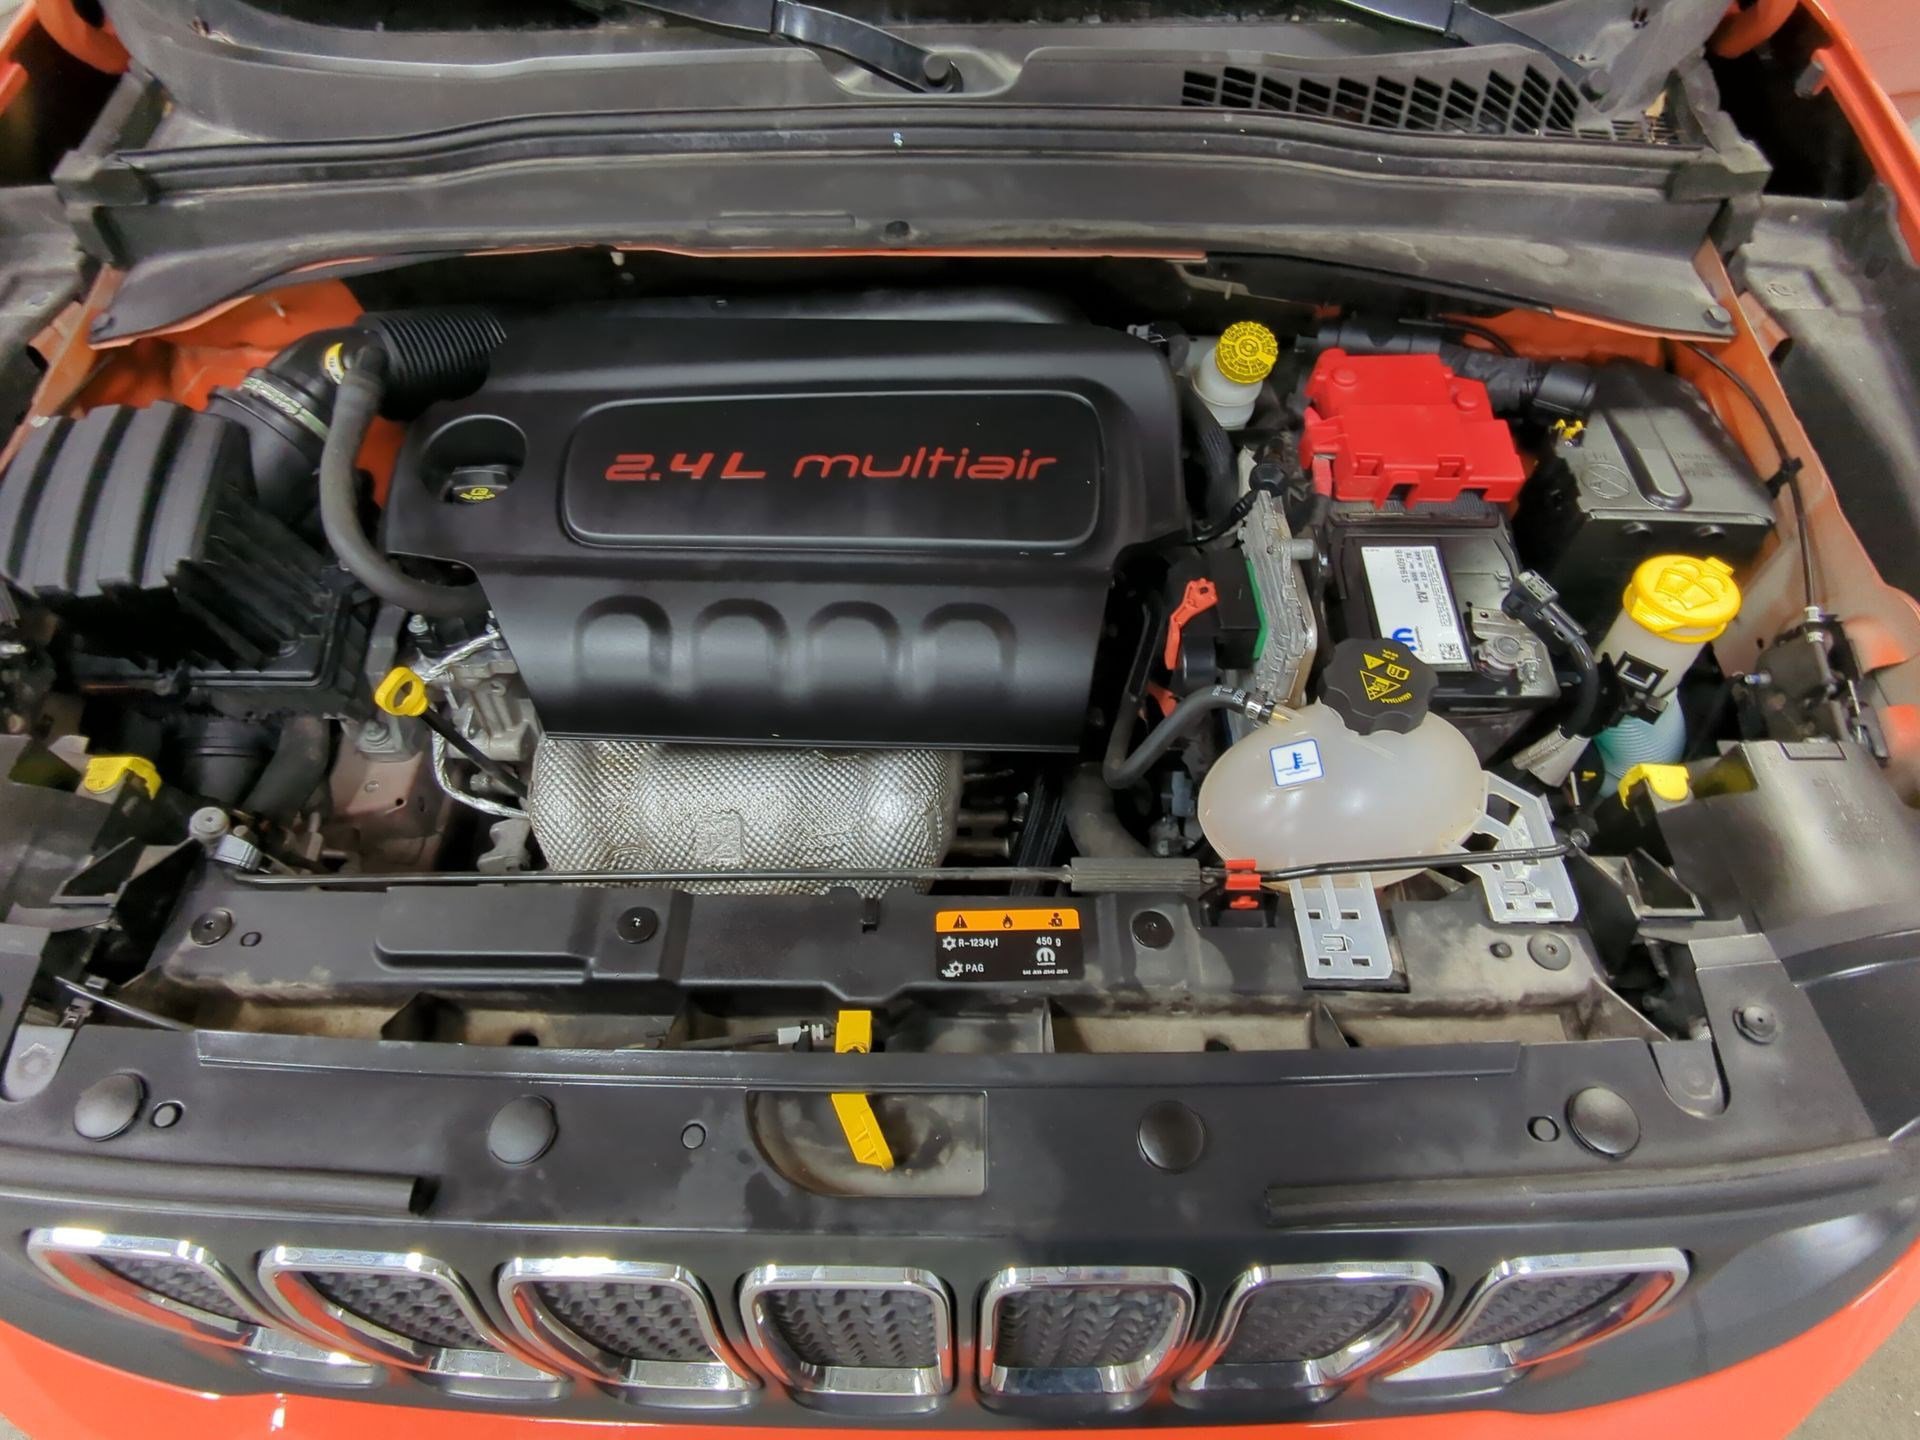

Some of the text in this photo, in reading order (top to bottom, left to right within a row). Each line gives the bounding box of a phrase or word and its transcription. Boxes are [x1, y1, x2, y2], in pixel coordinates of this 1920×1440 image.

[793, 446, 1057, 480] multiair
[1416, 591, 1429, 603] 12V
[1036, 936, 1062, 947] 450 g
[965, 963, 984, 973] PAG
